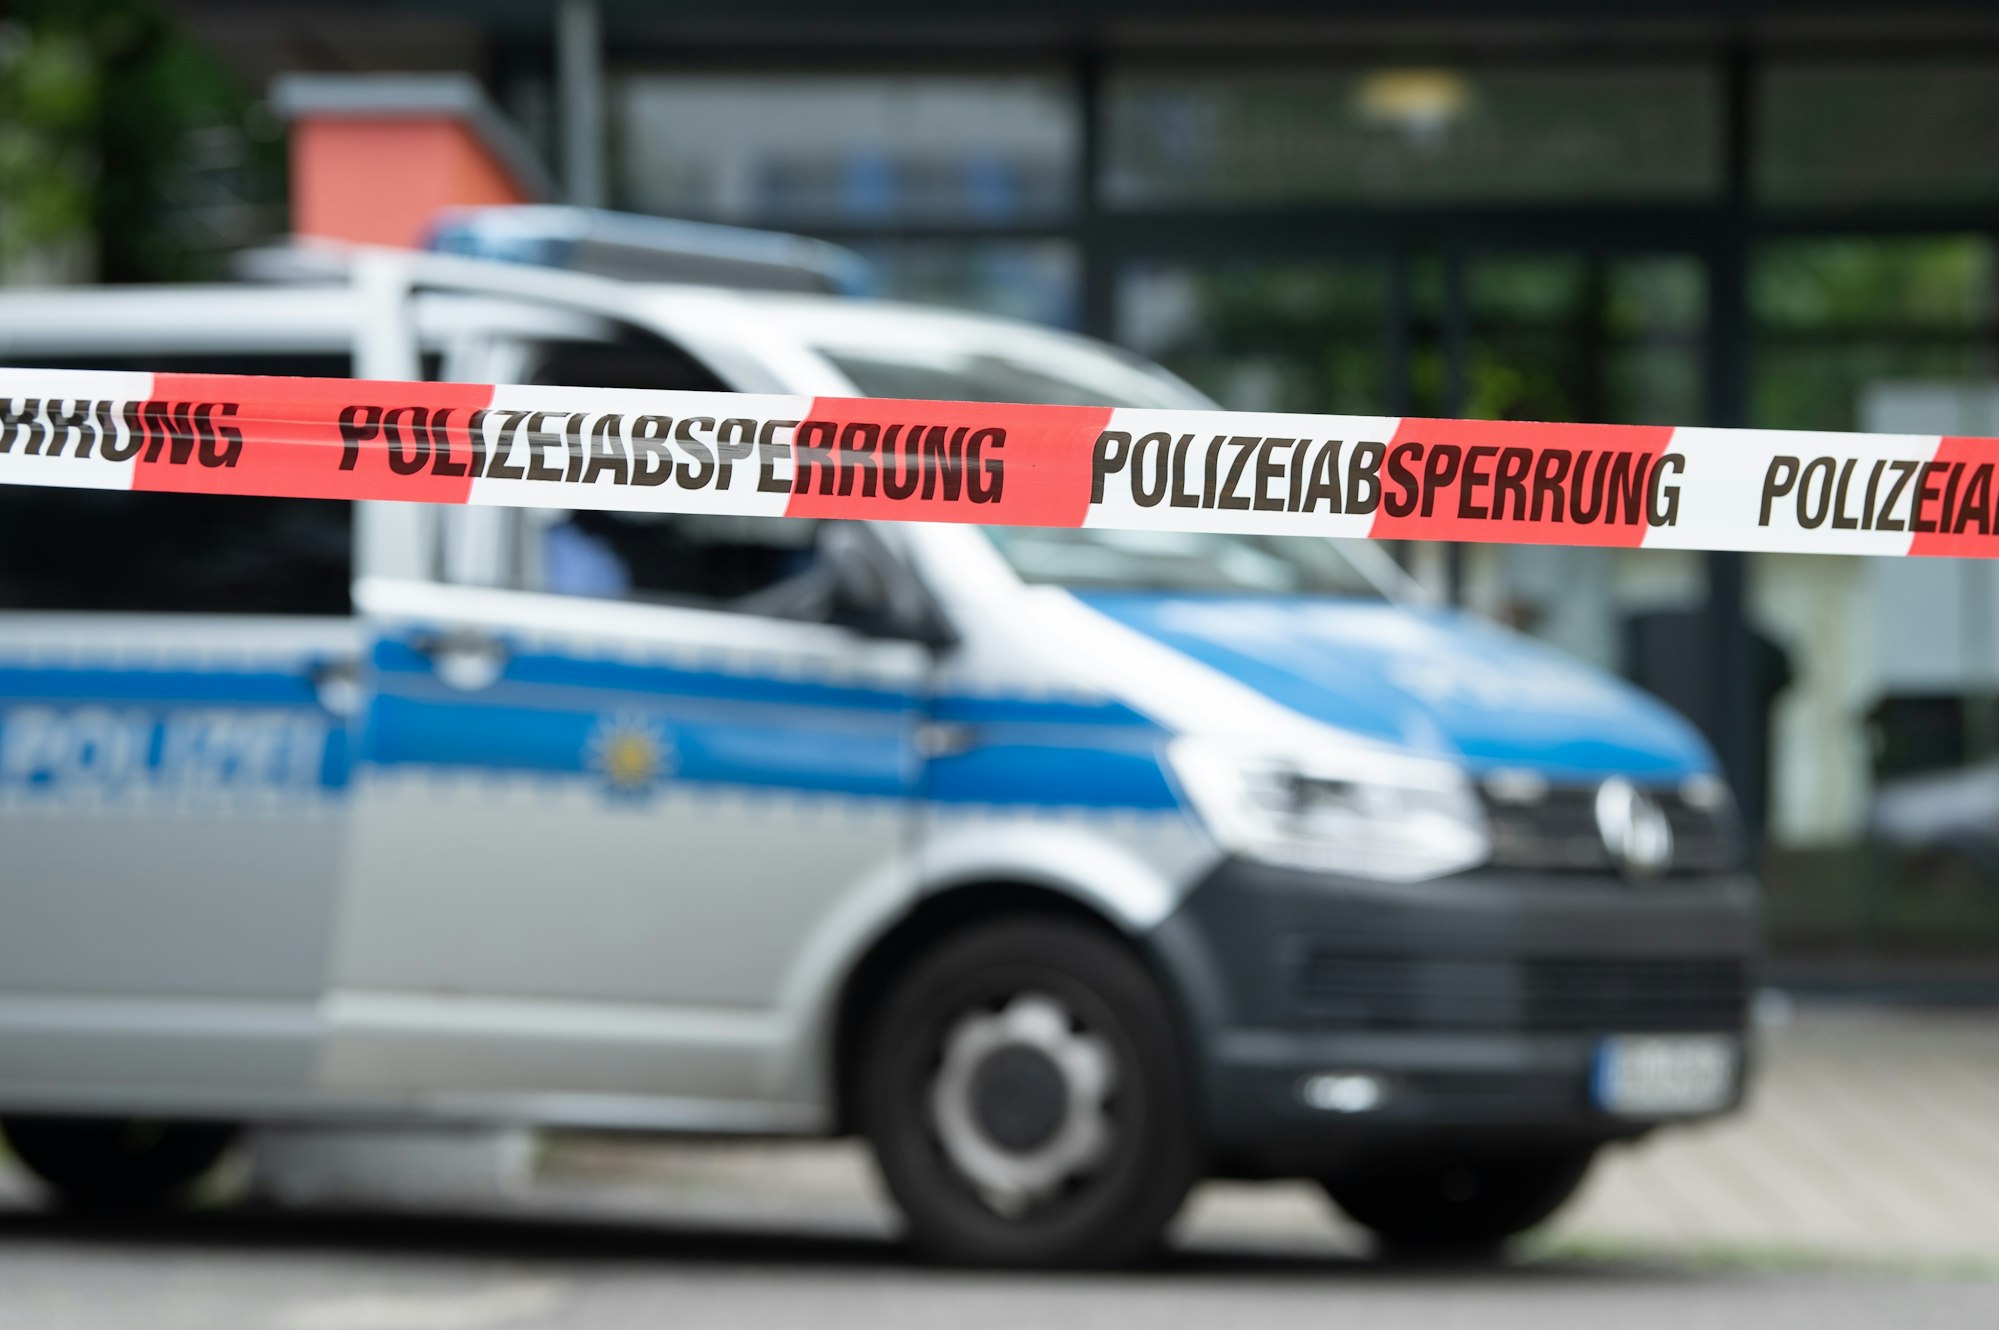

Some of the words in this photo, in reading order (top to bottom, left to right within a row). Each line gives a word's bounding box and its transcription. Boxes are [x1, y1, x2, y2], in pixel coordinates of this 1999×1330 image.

[338, 405, 1006, 504] POLIZEIABSPERRUNG
[1090, 430, 1685, 527] POLIZEIABSPERRUNG
[1758, 456, 1999, 536] POLIZEIA
[2, 707, 323, 791] POLIZEI
